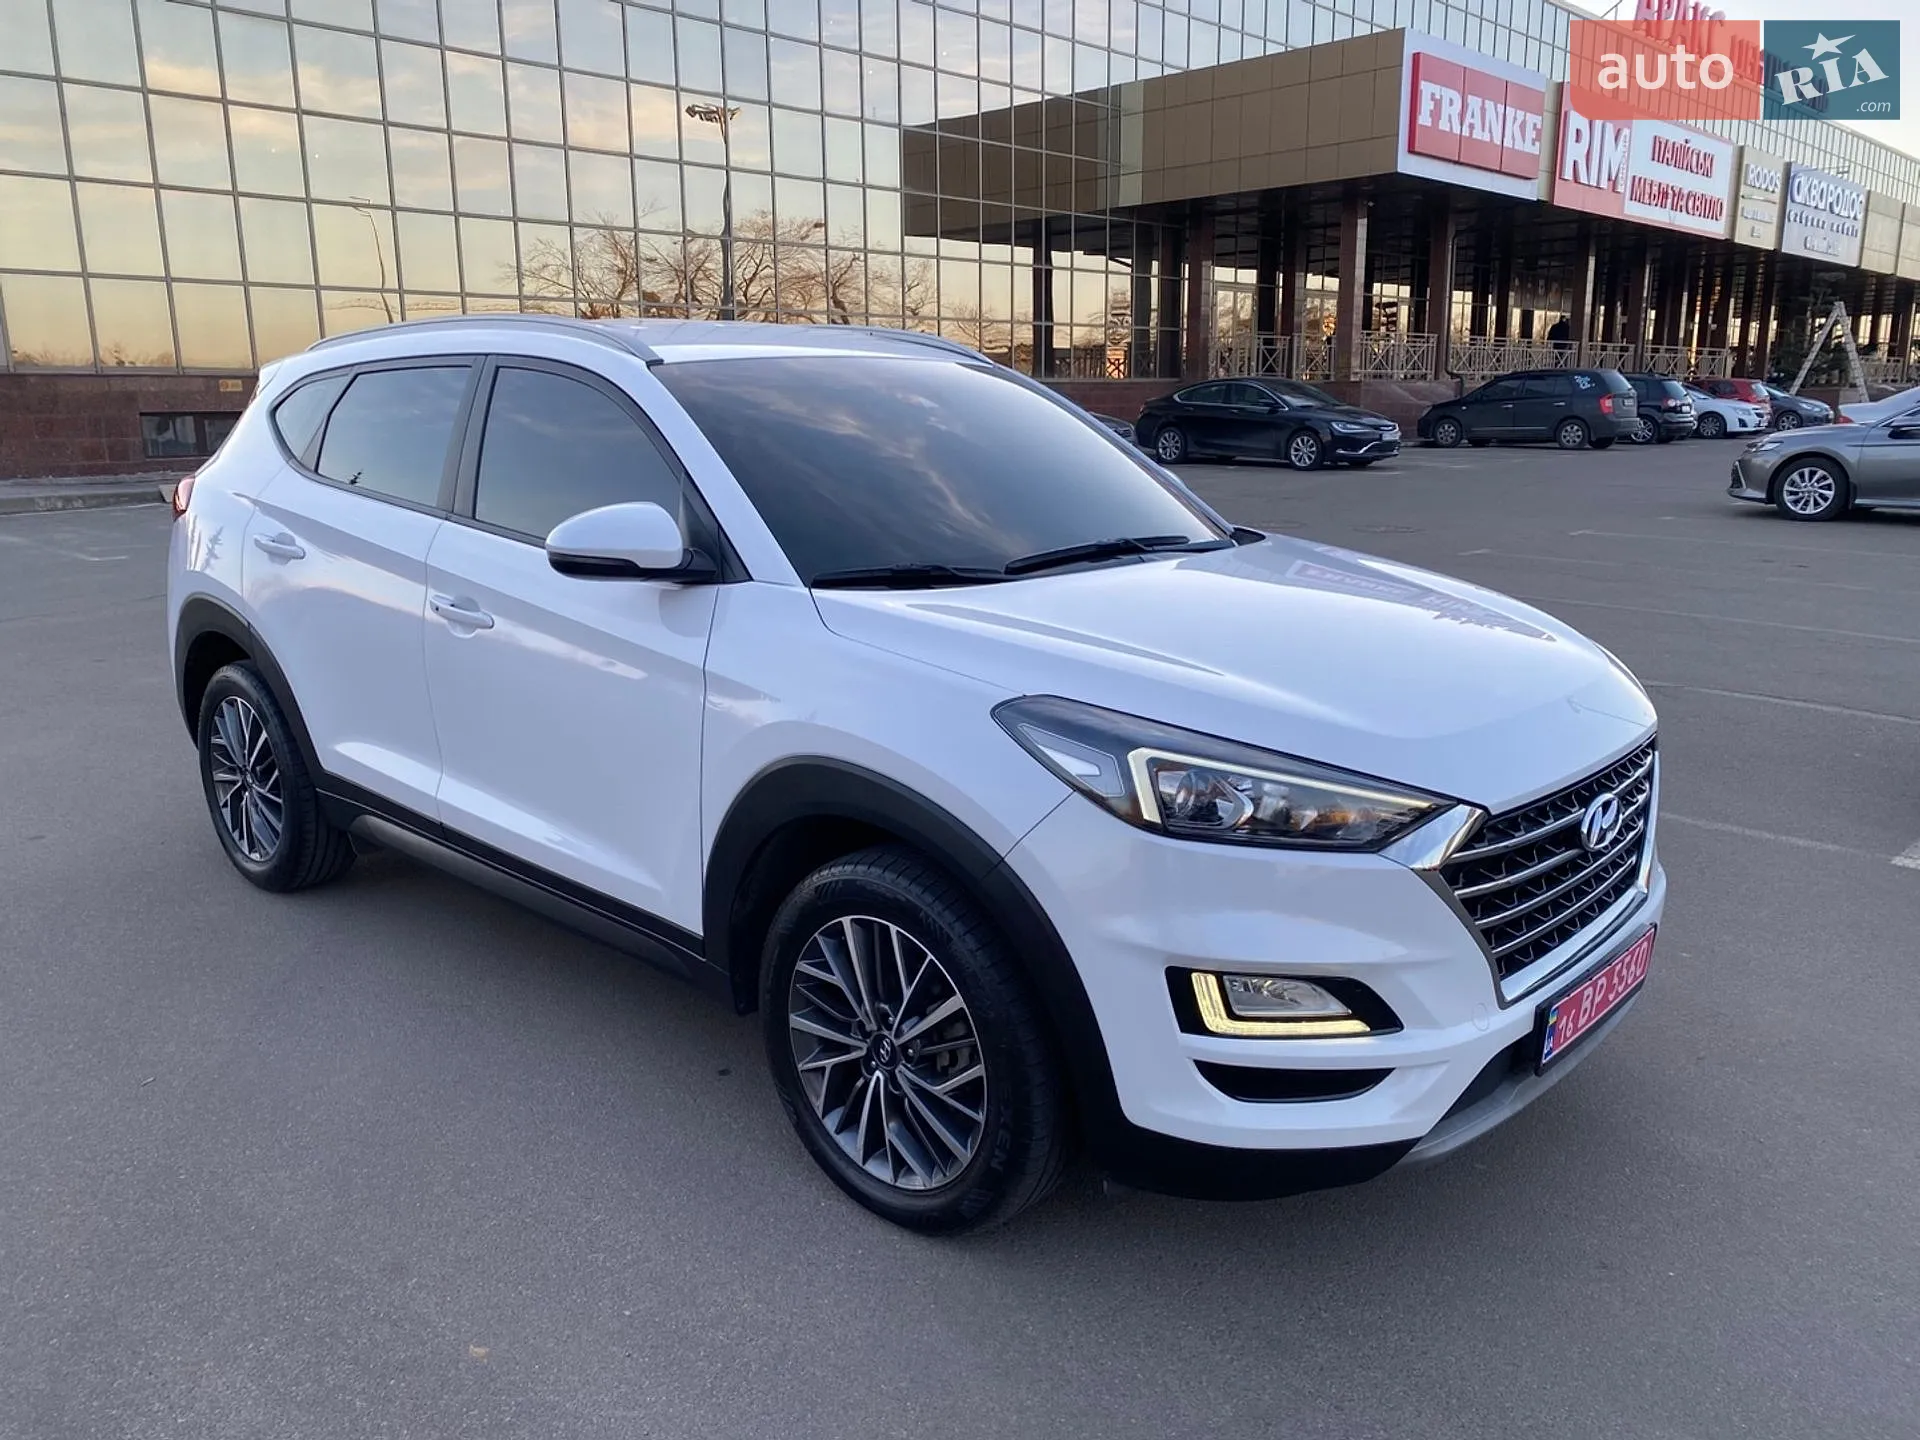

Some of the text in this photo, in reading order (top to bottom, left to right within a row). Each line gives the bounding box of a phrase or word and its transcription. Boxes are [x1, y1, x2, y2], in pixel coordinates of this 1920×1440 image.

[1417, 80, 1543, 156] FRANKE
[1561, 109, 1631, 193] RIM
[1747, 163, 1781, 193] RODOS
[1558, 1009, 1576, 1043] 16
